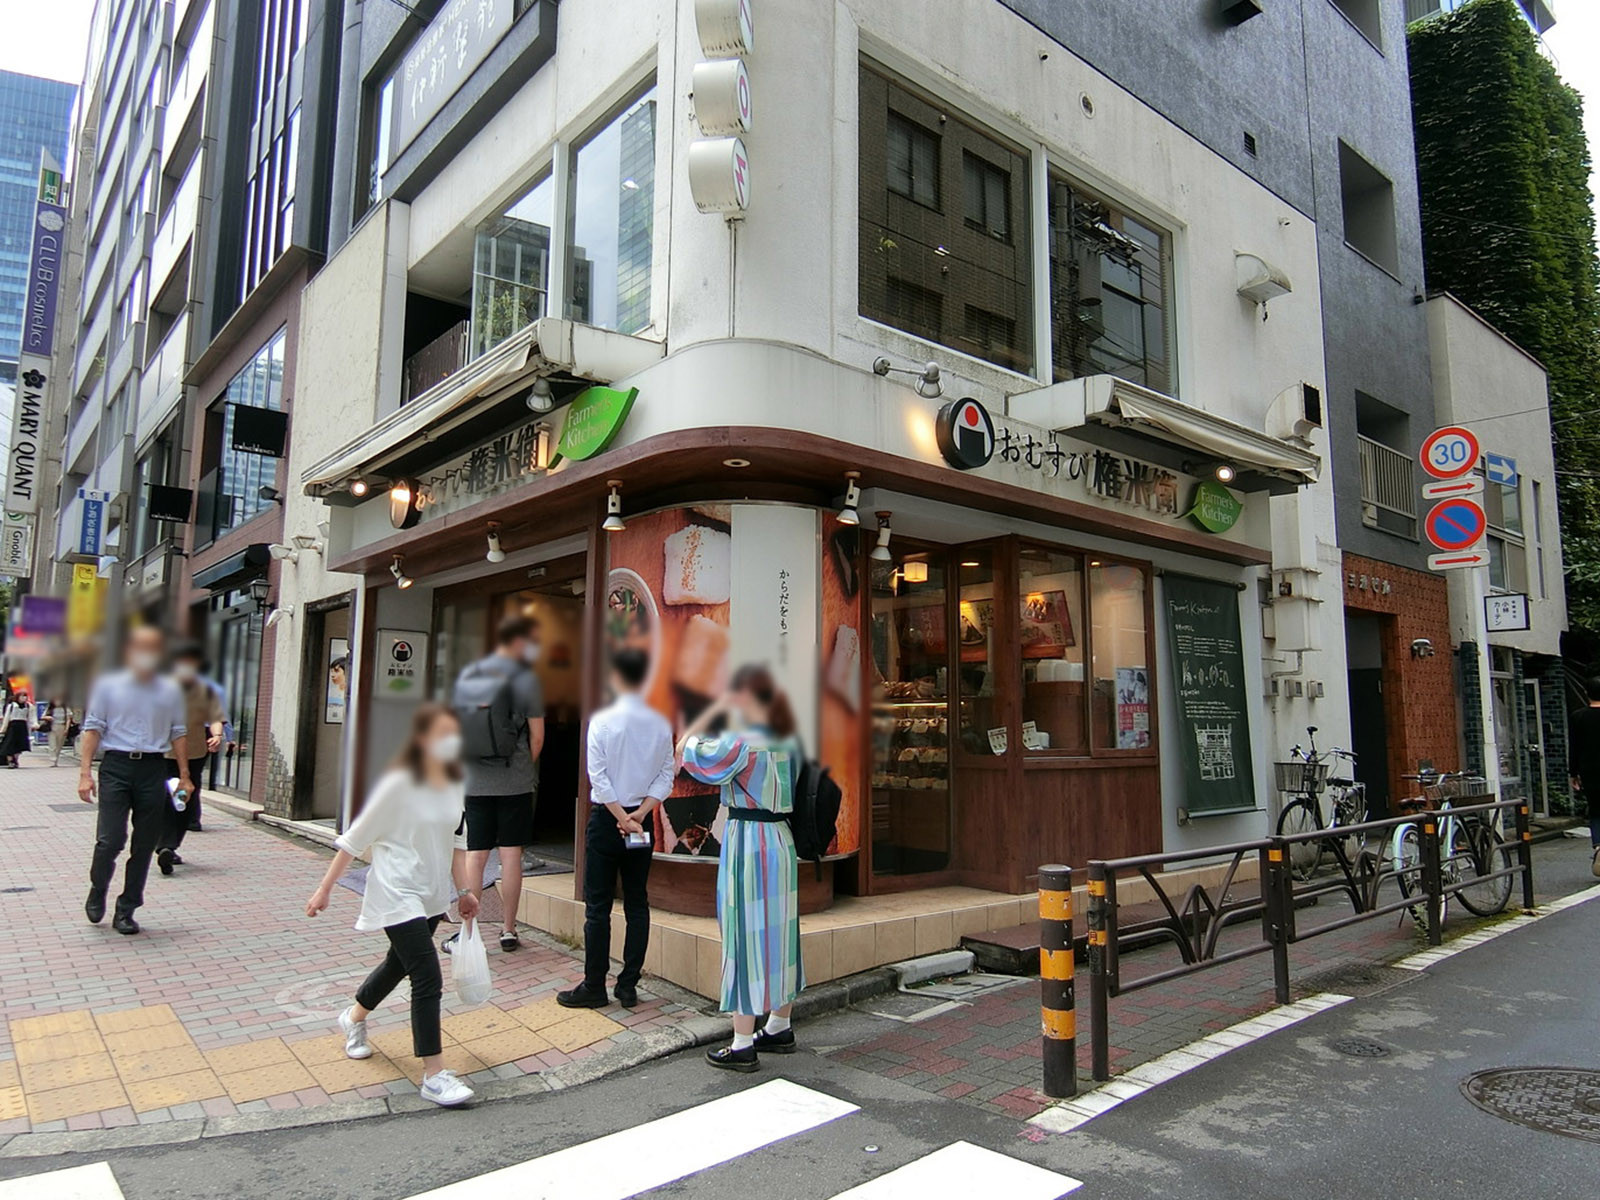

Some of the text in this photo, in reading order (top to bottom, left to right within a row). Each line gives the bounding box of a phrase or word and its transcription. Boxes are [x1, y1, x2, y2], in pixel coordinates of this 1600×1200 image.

[12, 391, 42, 500] MARY QUANT
[566, 420, 610, 449] Kitchen
[1434, 441, 1466, 465] 30
[1200, 486, 1234, 510] Farmer's
[1201, 504, 1234, 525] Kitchen
